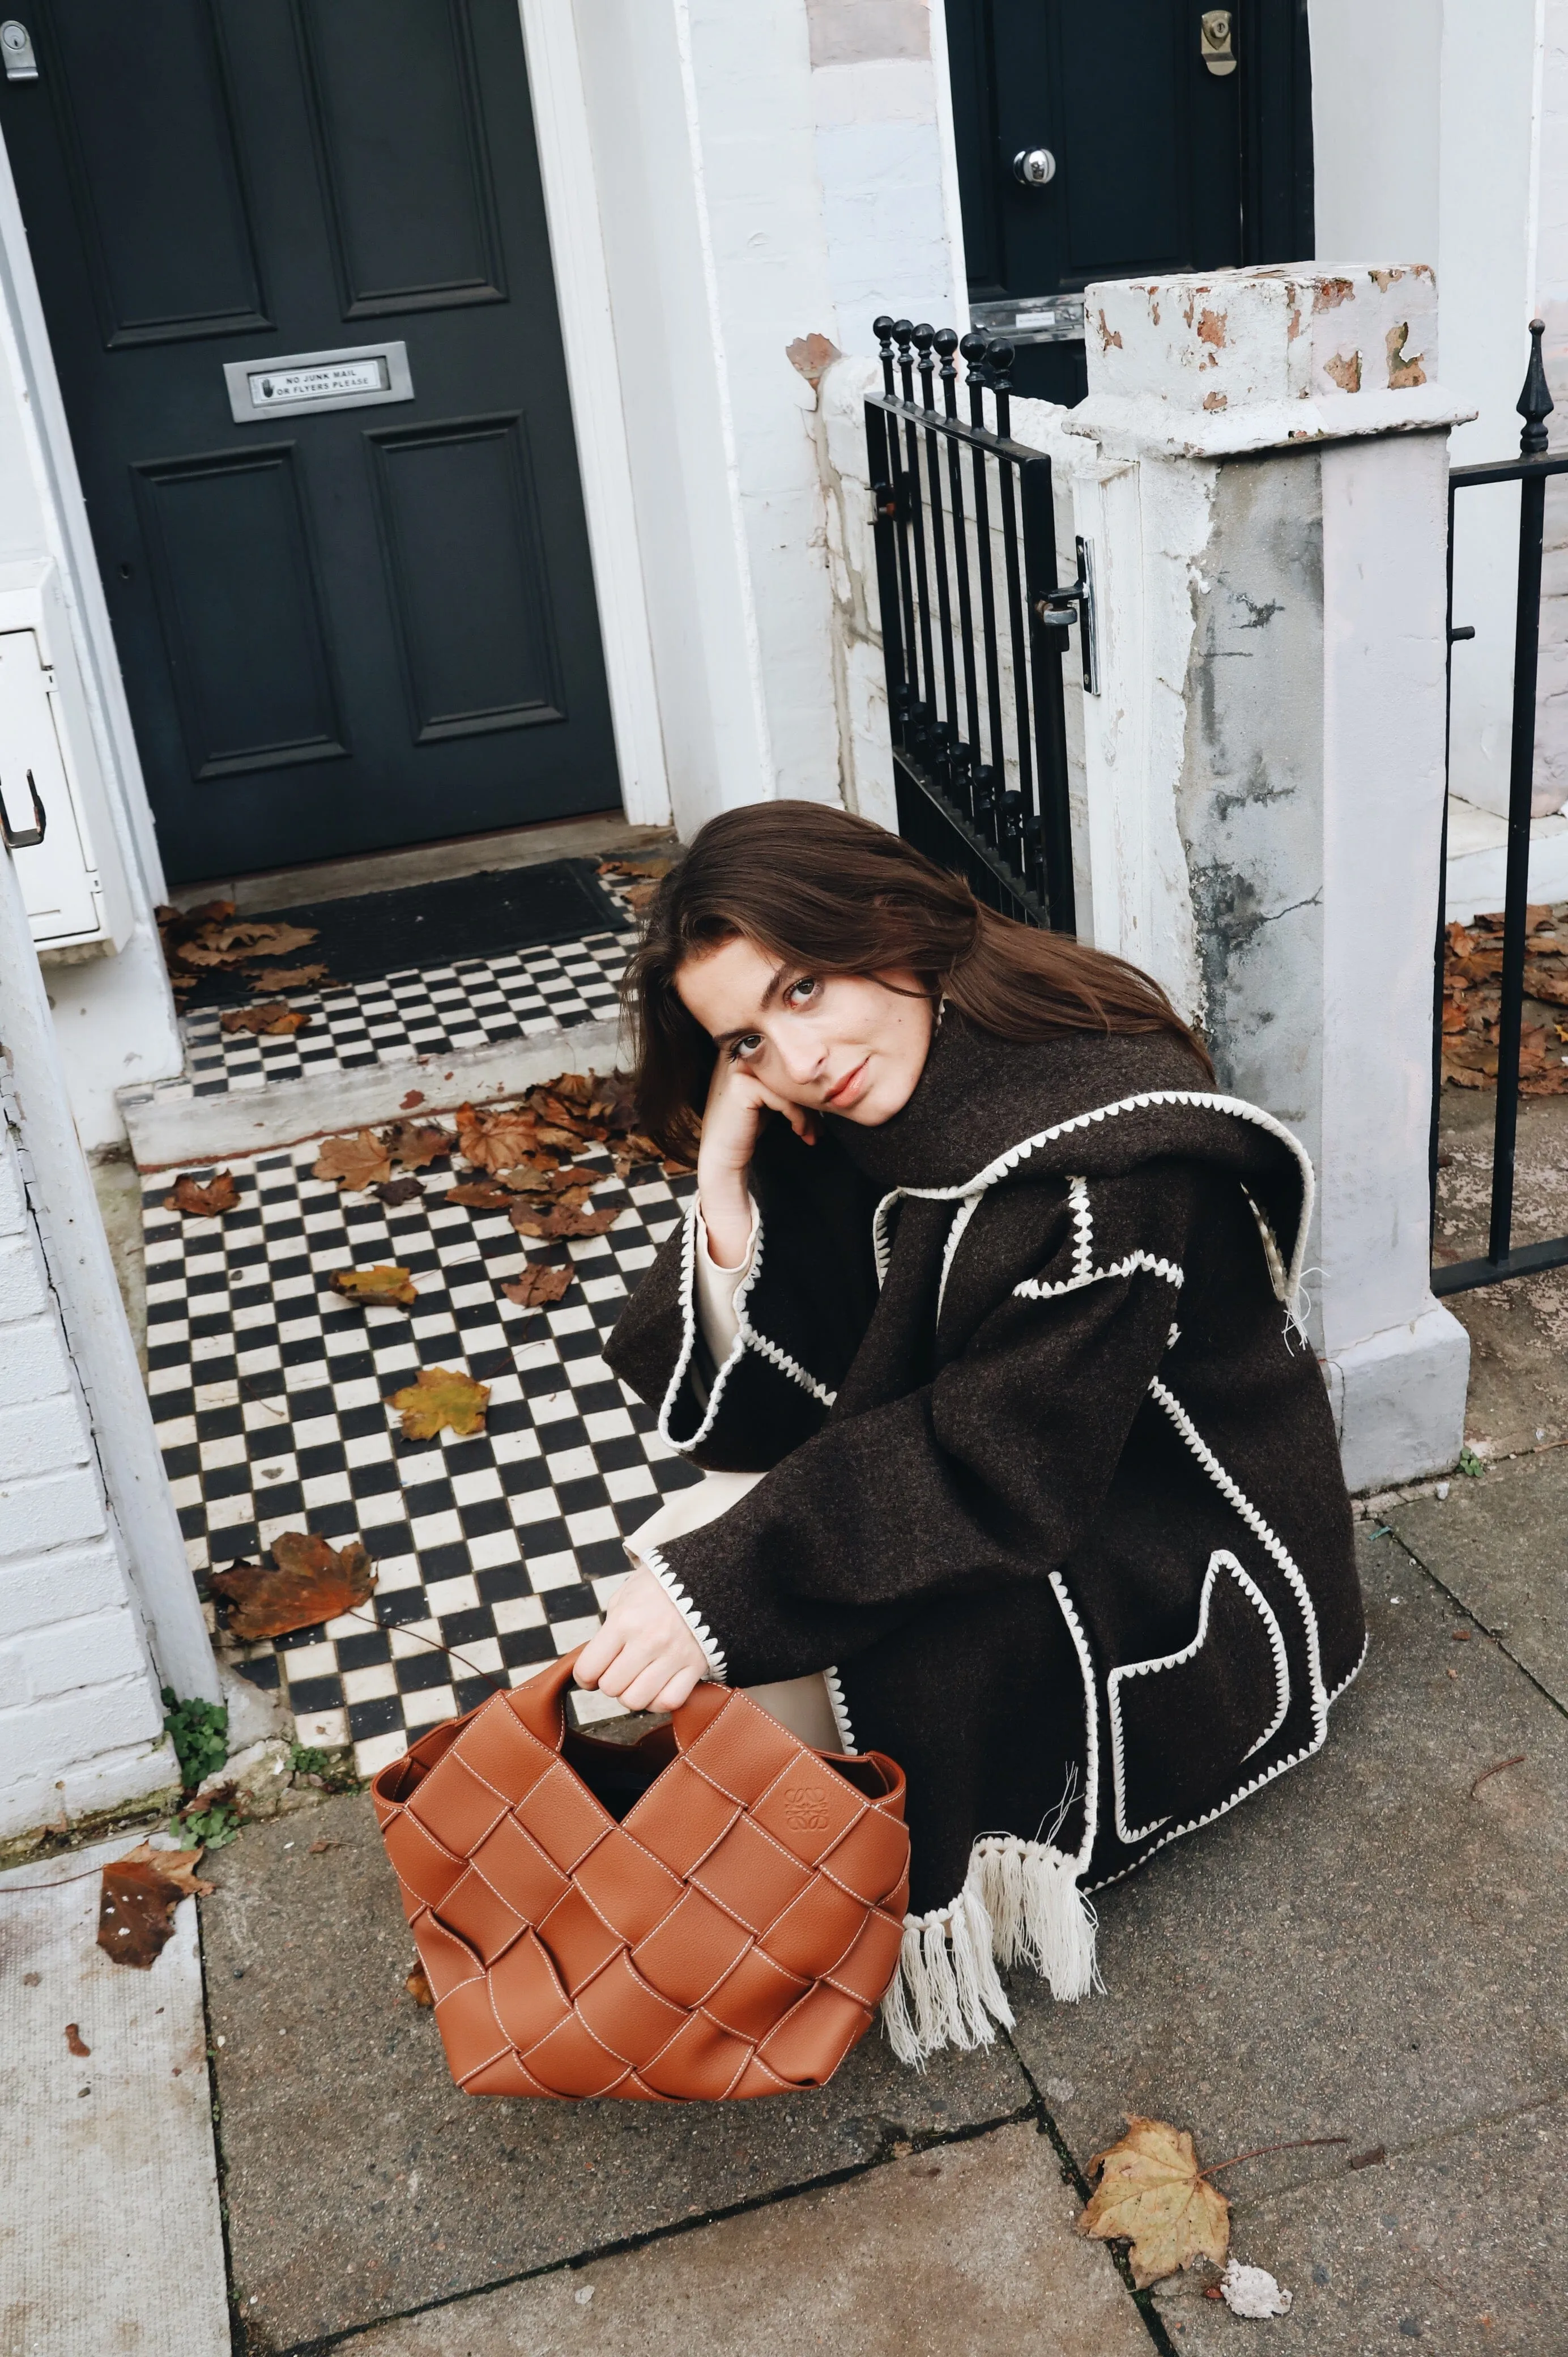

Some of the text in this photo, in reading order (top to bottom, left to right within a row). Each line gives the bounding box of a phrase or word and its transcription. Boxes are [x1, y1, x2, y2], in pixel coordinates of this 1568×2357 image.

[304, 373, 330, 382] JUNK
[333, 369, 357, 378] MAIL
[293, 382, 329, 393] FLYERS
[333, 377, 369, 388] PLEASE
